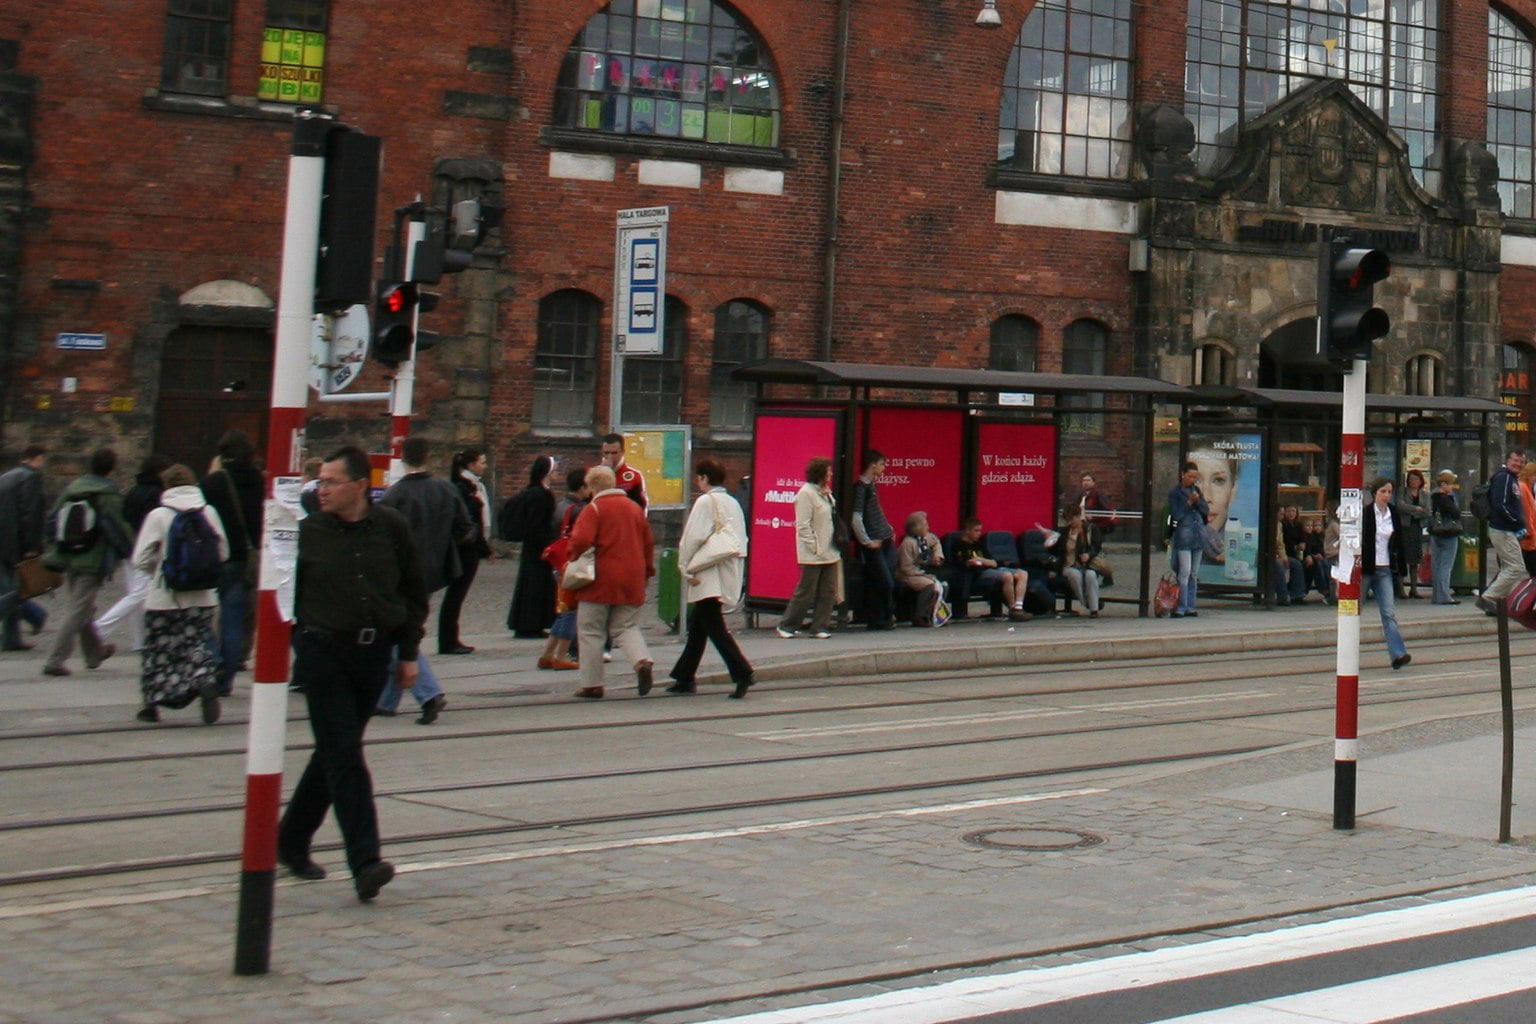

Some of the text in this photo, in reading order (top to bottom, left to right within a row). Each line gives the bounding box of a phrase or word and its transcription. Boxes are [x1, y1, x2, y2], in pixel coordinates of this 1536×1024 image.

[618, 208, 667, 219] HALA TARGOWA
[892, 459, 904, 467] na
[905, 458, 935, 469] pewno
[982, 454, 1047, 468] W końcu każdy
[981, 472, 1008, 485] gdzieś
